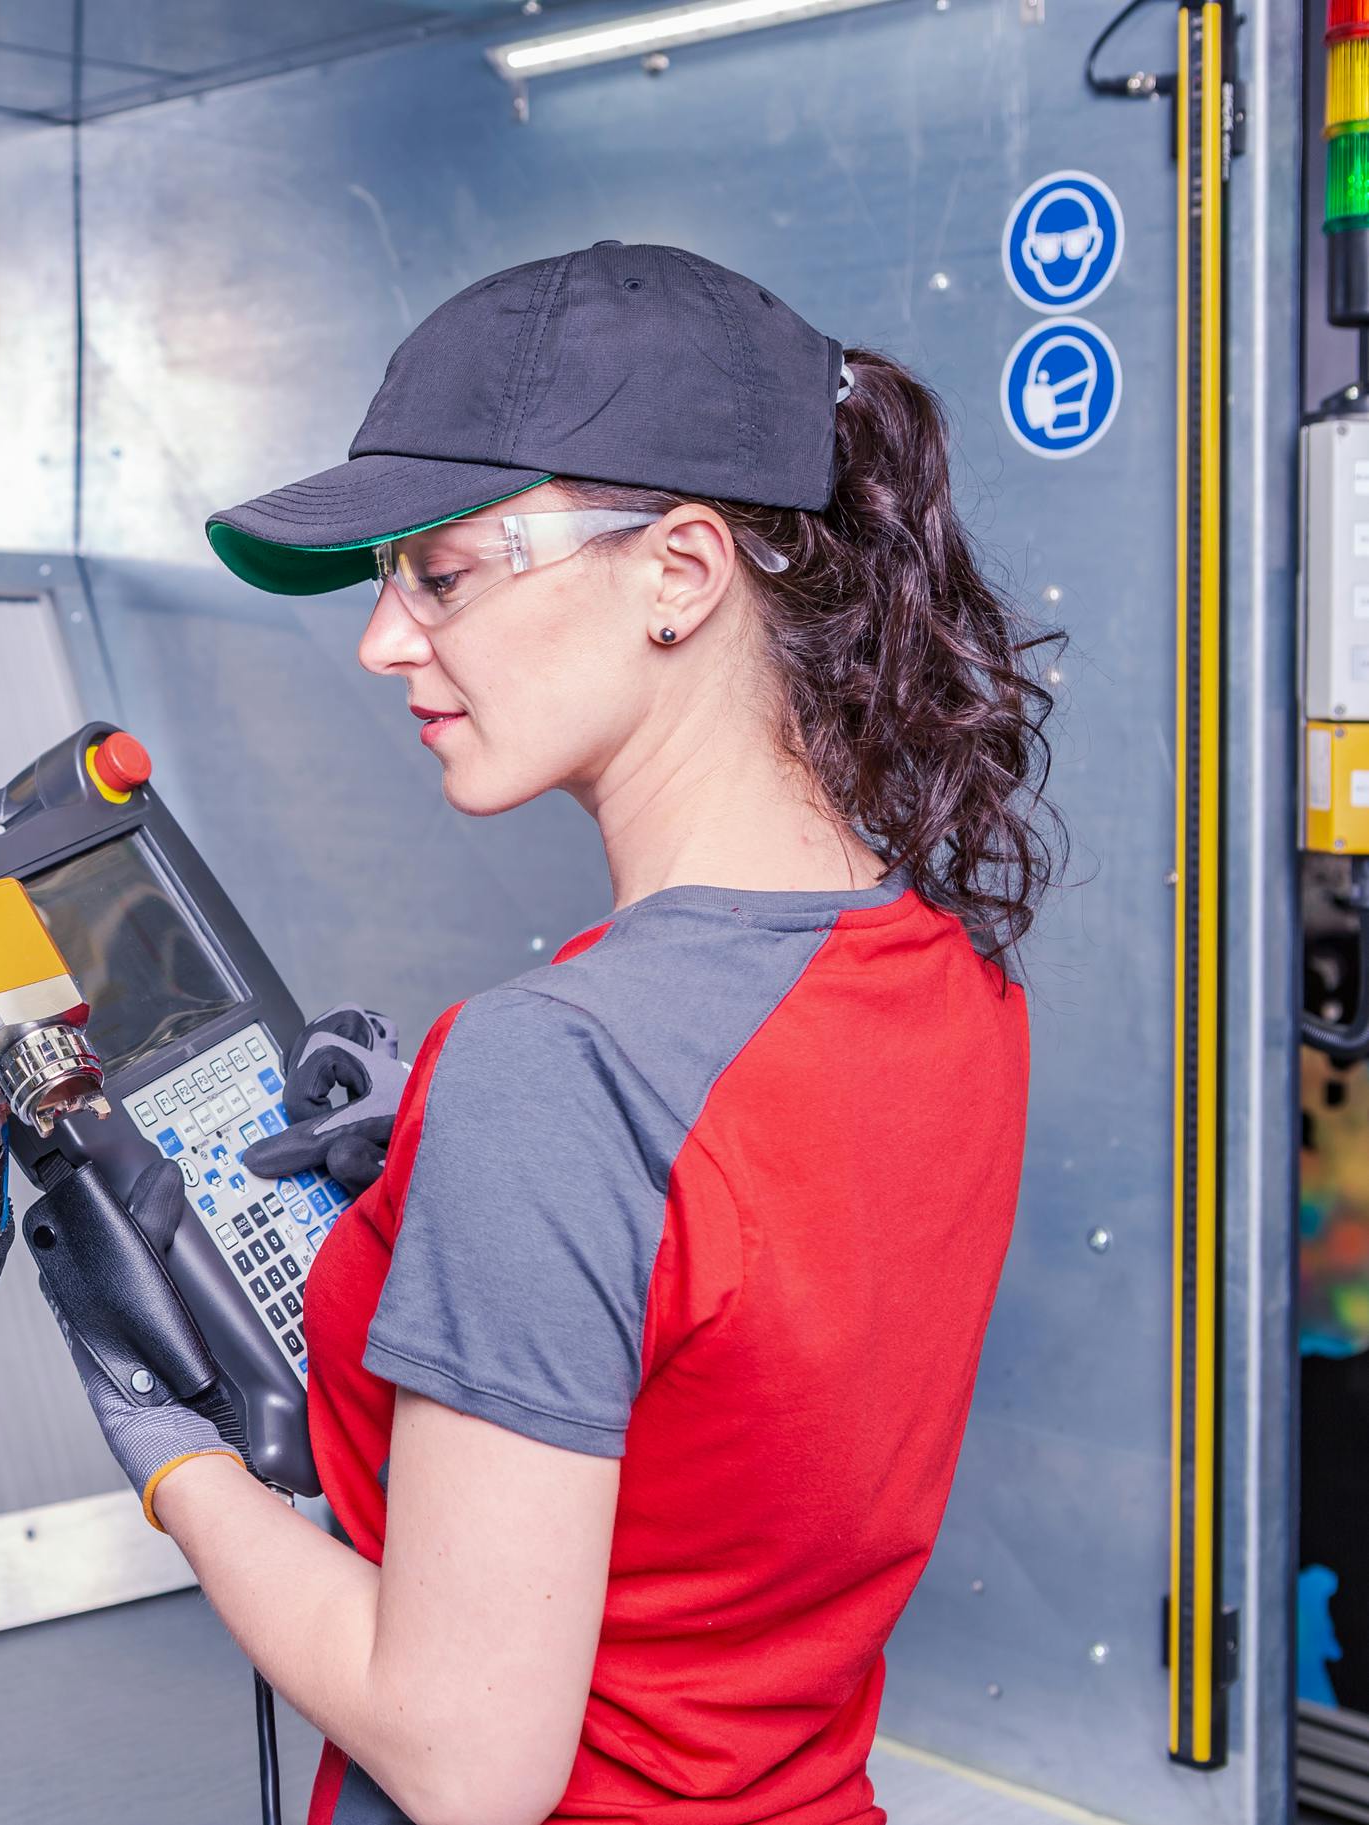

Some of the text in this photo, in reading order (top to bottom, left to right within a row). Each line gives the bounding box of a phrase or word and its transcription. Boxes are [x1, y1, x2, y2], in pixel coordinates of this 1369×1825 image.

[233, 1054, 245, 1065] F5
[215, 1064, 226, 1075] F4
[197, 1075, 209, 1087] F3
[178, 1086, 191, 1098] F2
[160, 1097, 172, 1108] F1
[161, 1135, 179, 1150] SHIFT
[281, 1185, 295, 1198] FWD
[293, 1204, 307, 1217] BWD
[235, 1218, 248, 1228] BACK
[270, 1235, 279, 1247] 9
[254, 1246, 264, 1258] 8
[238, 1256, 248, 1269] 7
[286, 1261, 296, 1273] 6
[271, 1271, 280, 1284] 5
[256, 1283, 265, 1295] 4
[287, 1298, 297, 1311] 2
[272, 1310, 281, 1321] 1
[288, 1337, 298, 1349] 0
